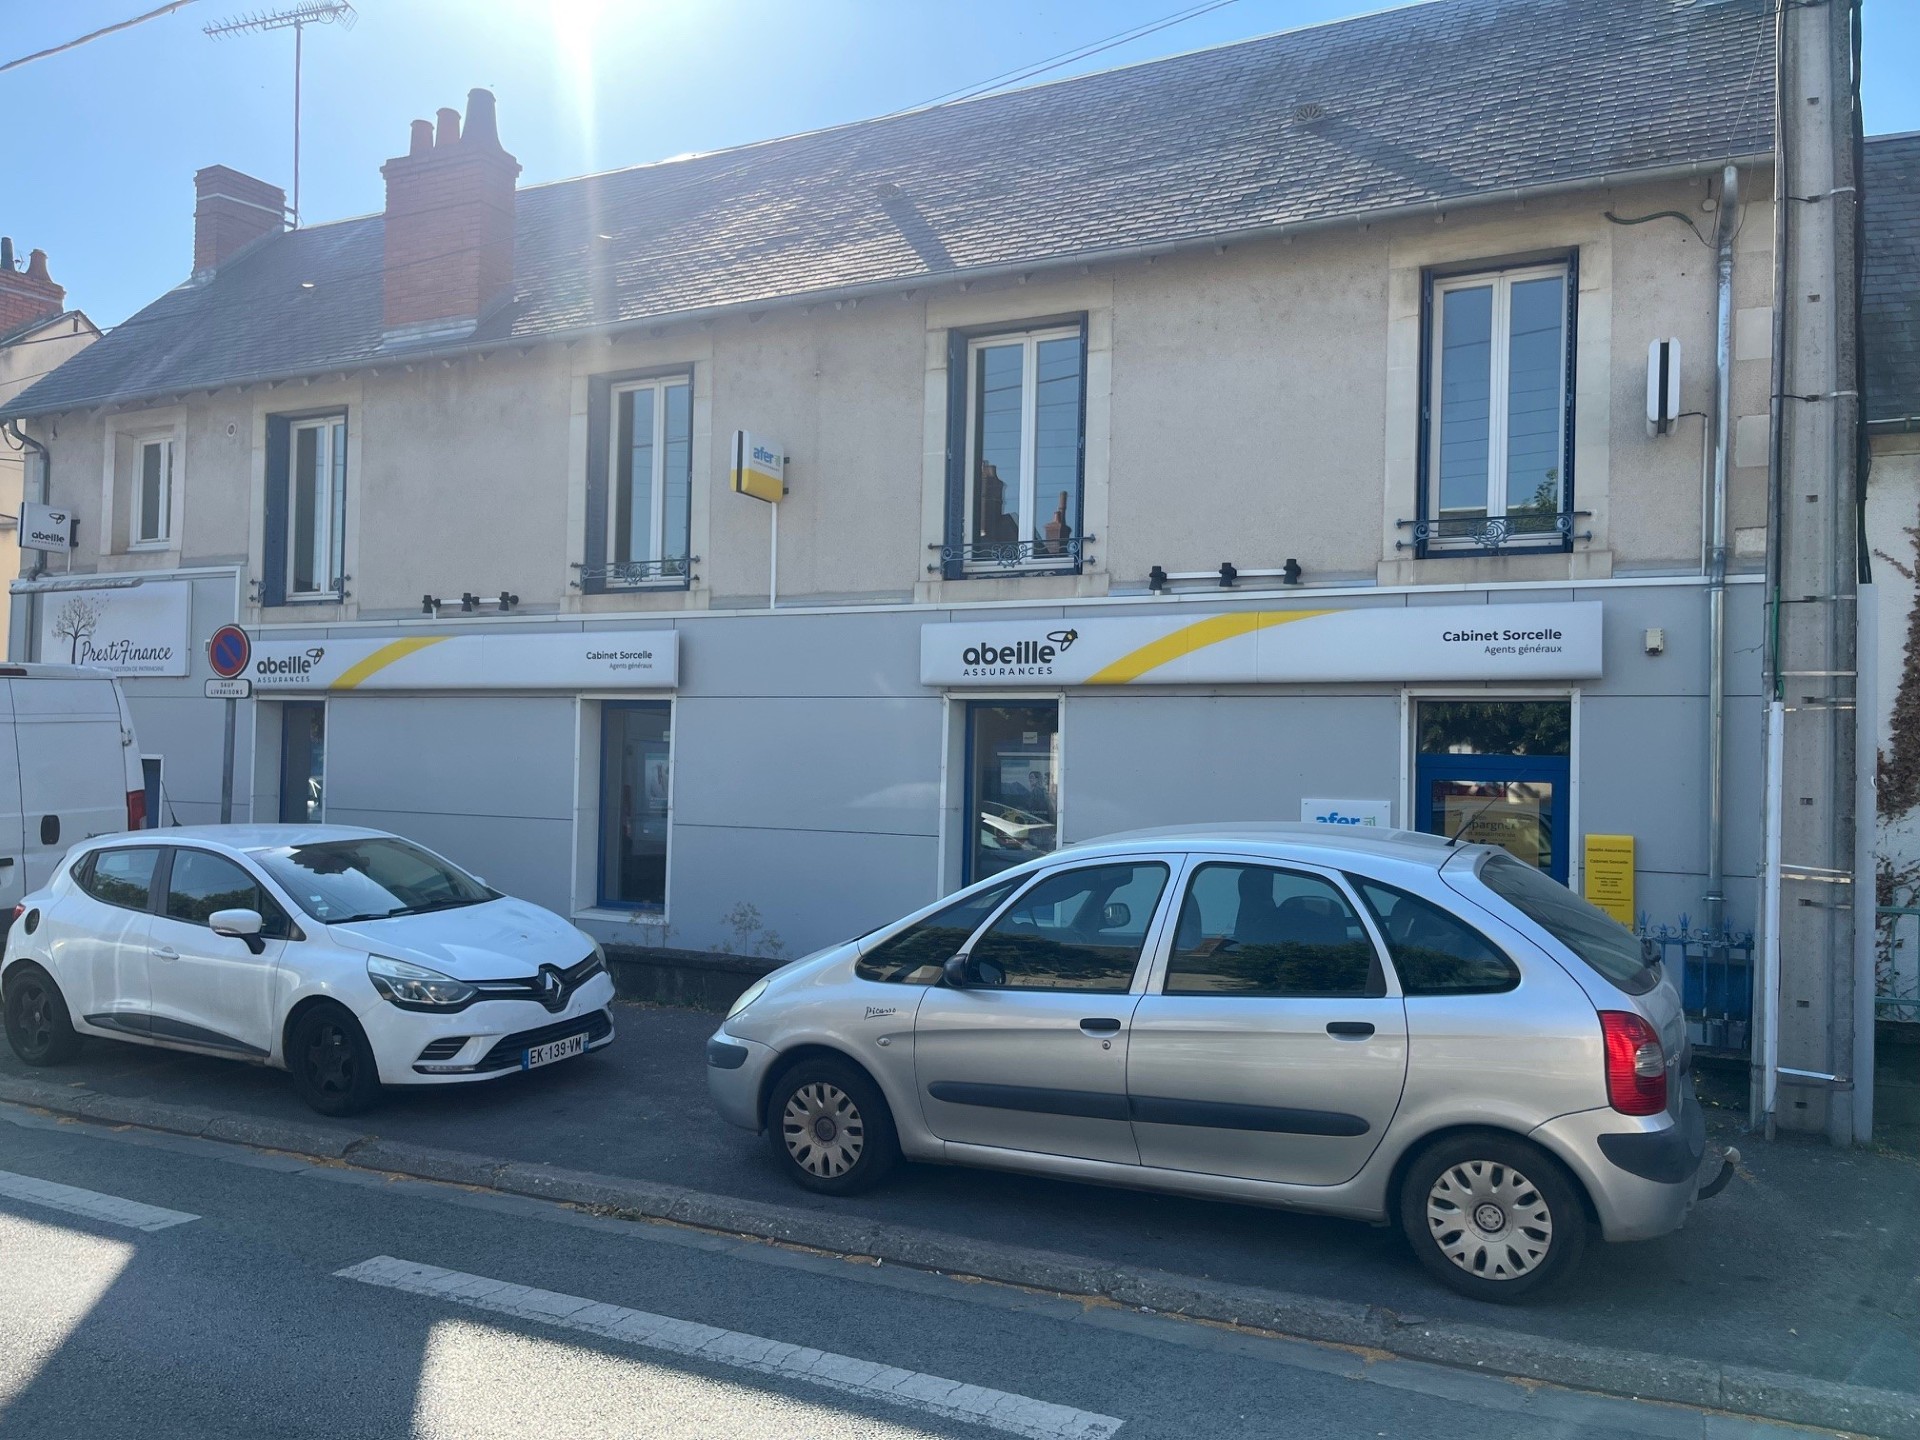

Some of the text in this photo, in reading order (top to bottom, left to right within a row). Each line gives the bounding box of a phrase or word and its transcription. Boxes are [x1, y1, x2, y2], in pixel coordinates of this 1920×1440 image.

[753, 446, 774, 464] afer
[31, 531, 65, 543] abeille
[1442, 629, 1563, 642] Cabinet Sorcelle
[80, 639, 174, 666] PrestiFinance
[586, 650, 653, 660] Cabinet Sorcelle
[962, 640, 1056, 666] abeille
[1484, 643, 1563, 656] Agents généraux
[256, 656, 312, 675] abeille
[609, 662, 653, 671] Agents généraux
[962, 666, 1053, 677] ASSURANCES
[257, 675, 311, 683] ASSURANCES
[864, 1006, 897, 1020] Picasso
[530, 1036, 582, 1065] EK-139-VM
